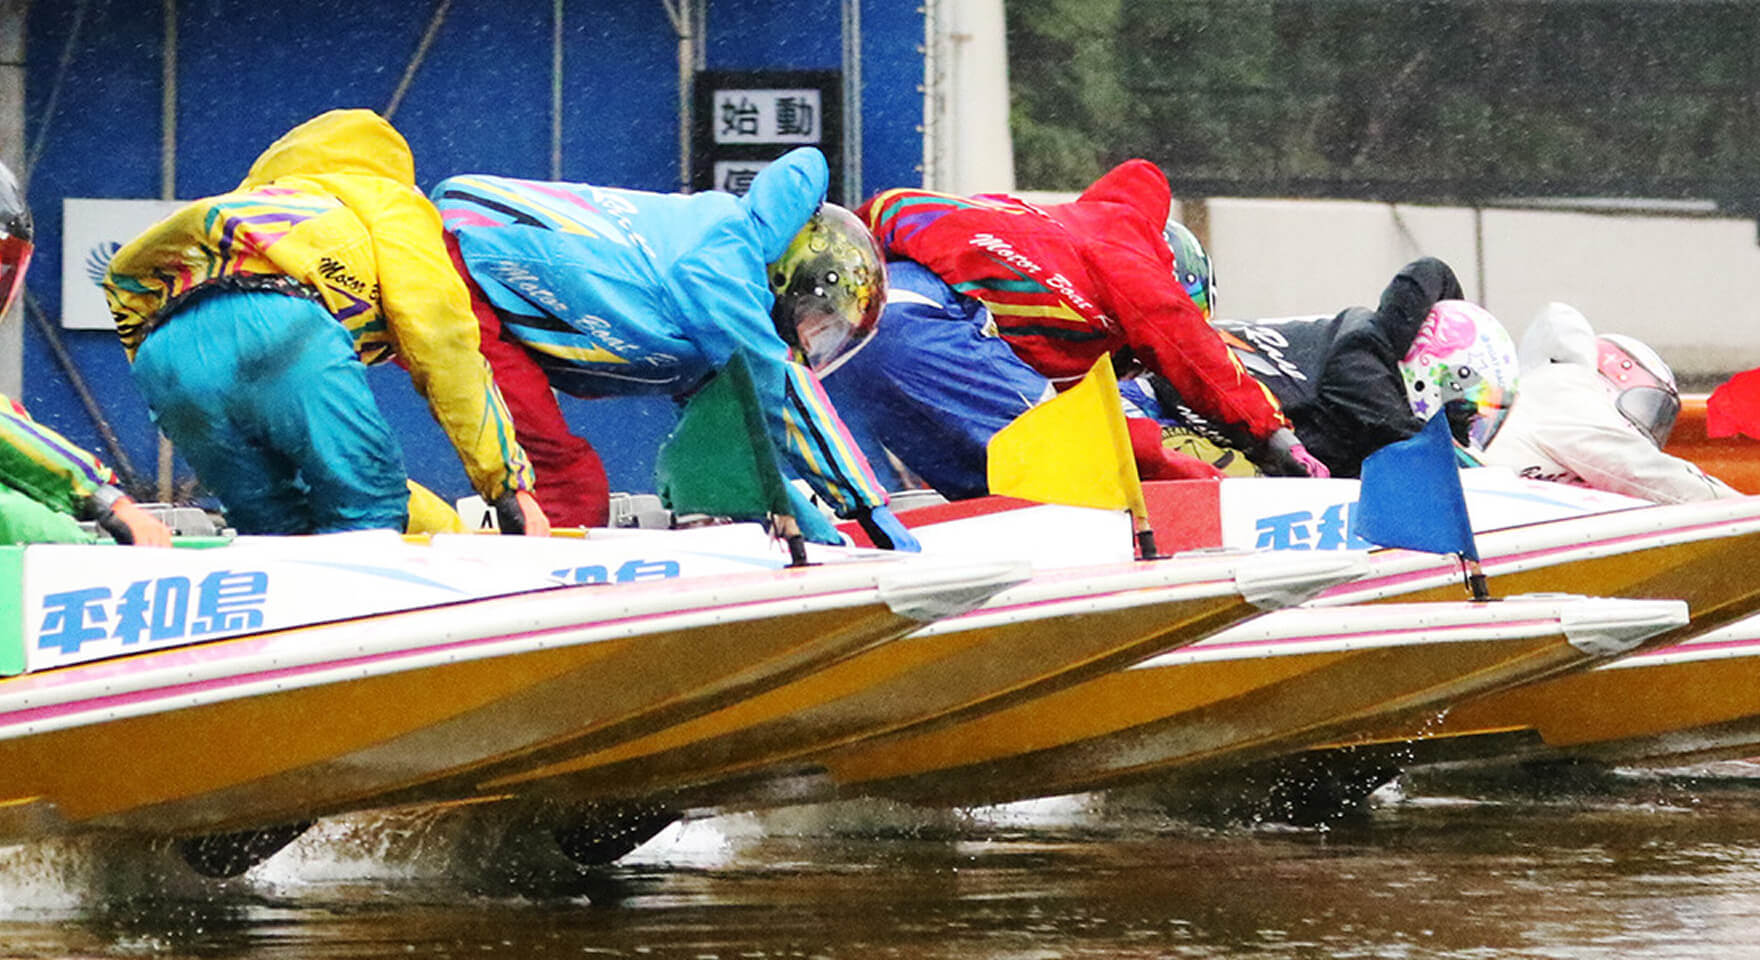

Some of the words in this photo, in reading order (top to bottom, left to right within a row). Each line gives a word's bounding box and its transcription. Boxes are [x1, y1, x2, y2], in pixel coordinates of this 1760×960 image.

[721, 97, 814, 136] 始動
[37, 569, 269, 655] 平和島
